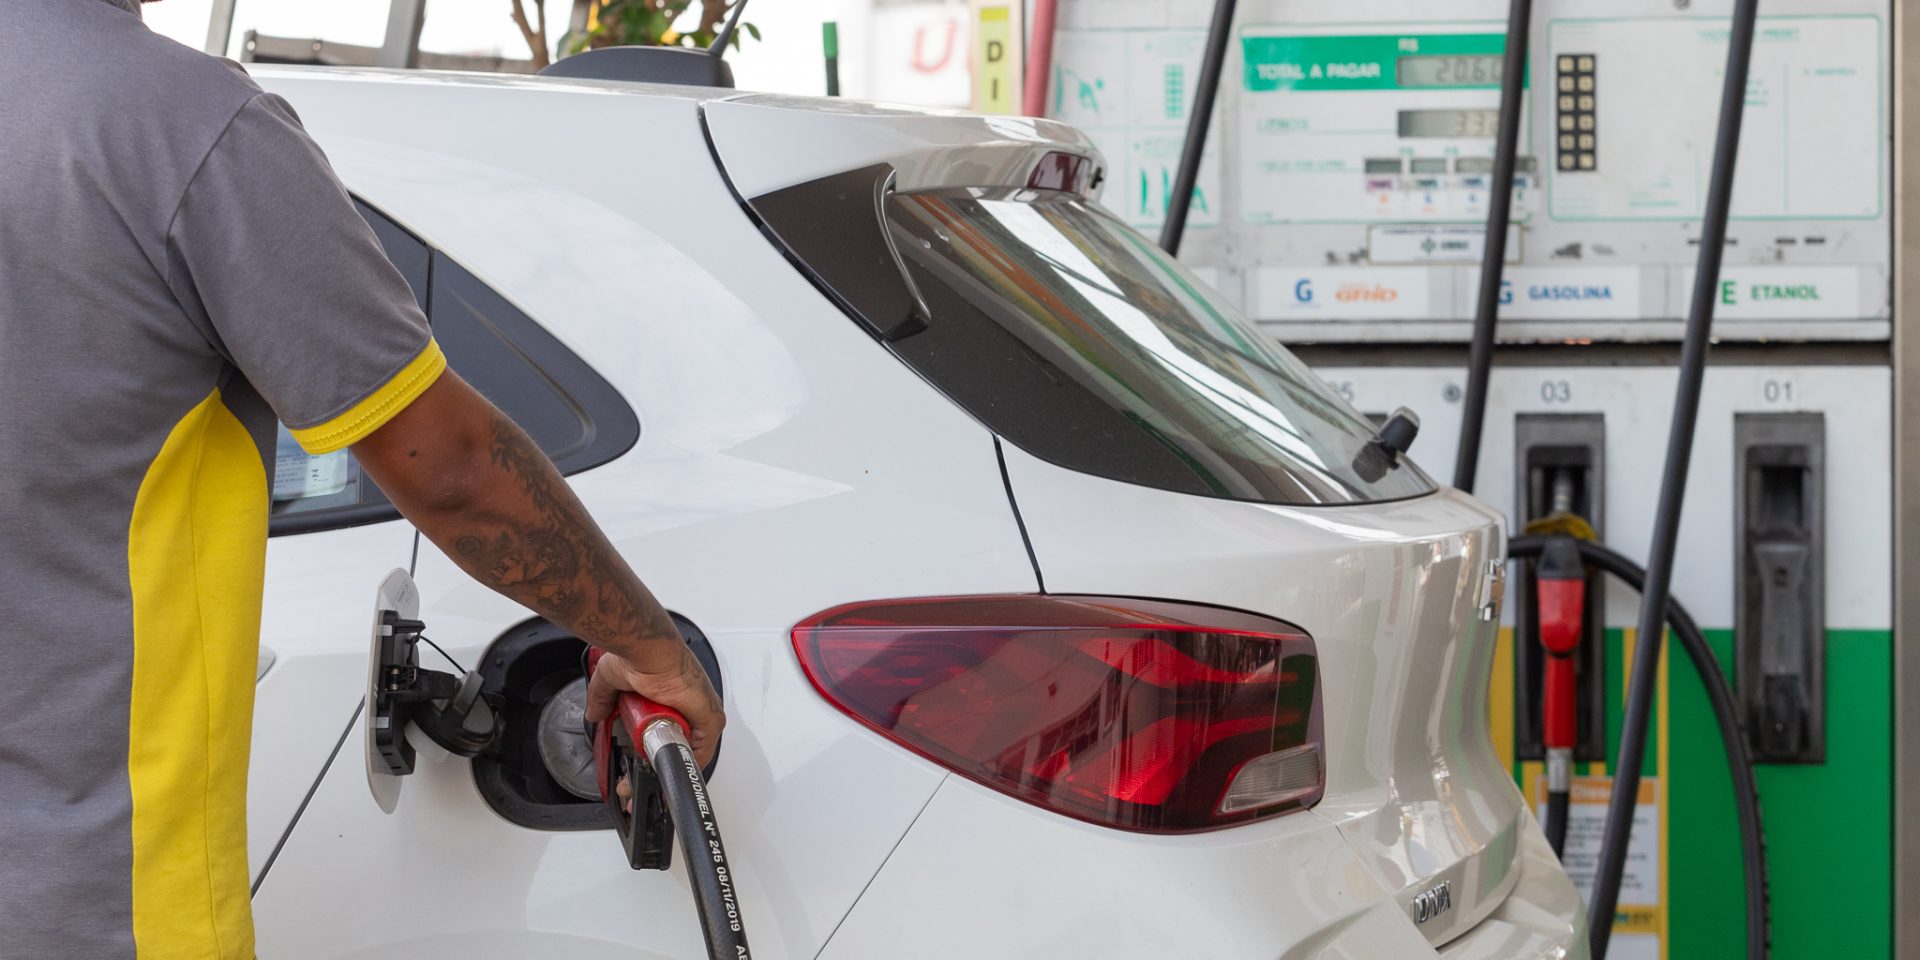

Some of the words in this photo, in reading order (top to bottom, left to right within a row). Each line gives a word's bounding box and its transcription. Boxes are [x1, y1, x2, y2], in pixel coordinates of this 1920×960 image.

[1256, 63, 1305, 80] TOTAL
[1309, 63, 1323, 79] A
[1326, 62, 1381, 79] PAGAR
[1295, 279, 1313, 303] G
[1528, 285, 1612, 301] GASOLINA
[1722, 280, 1737, 305] E
[1751, 285, 1820, 301] ETANOL
[1540, 380, 1572, 404] 03
[1764, 379, 1793, 403] 01
[709, 839, 724, 863] 245
[716, 866, 741, 932] 08/11/2019
